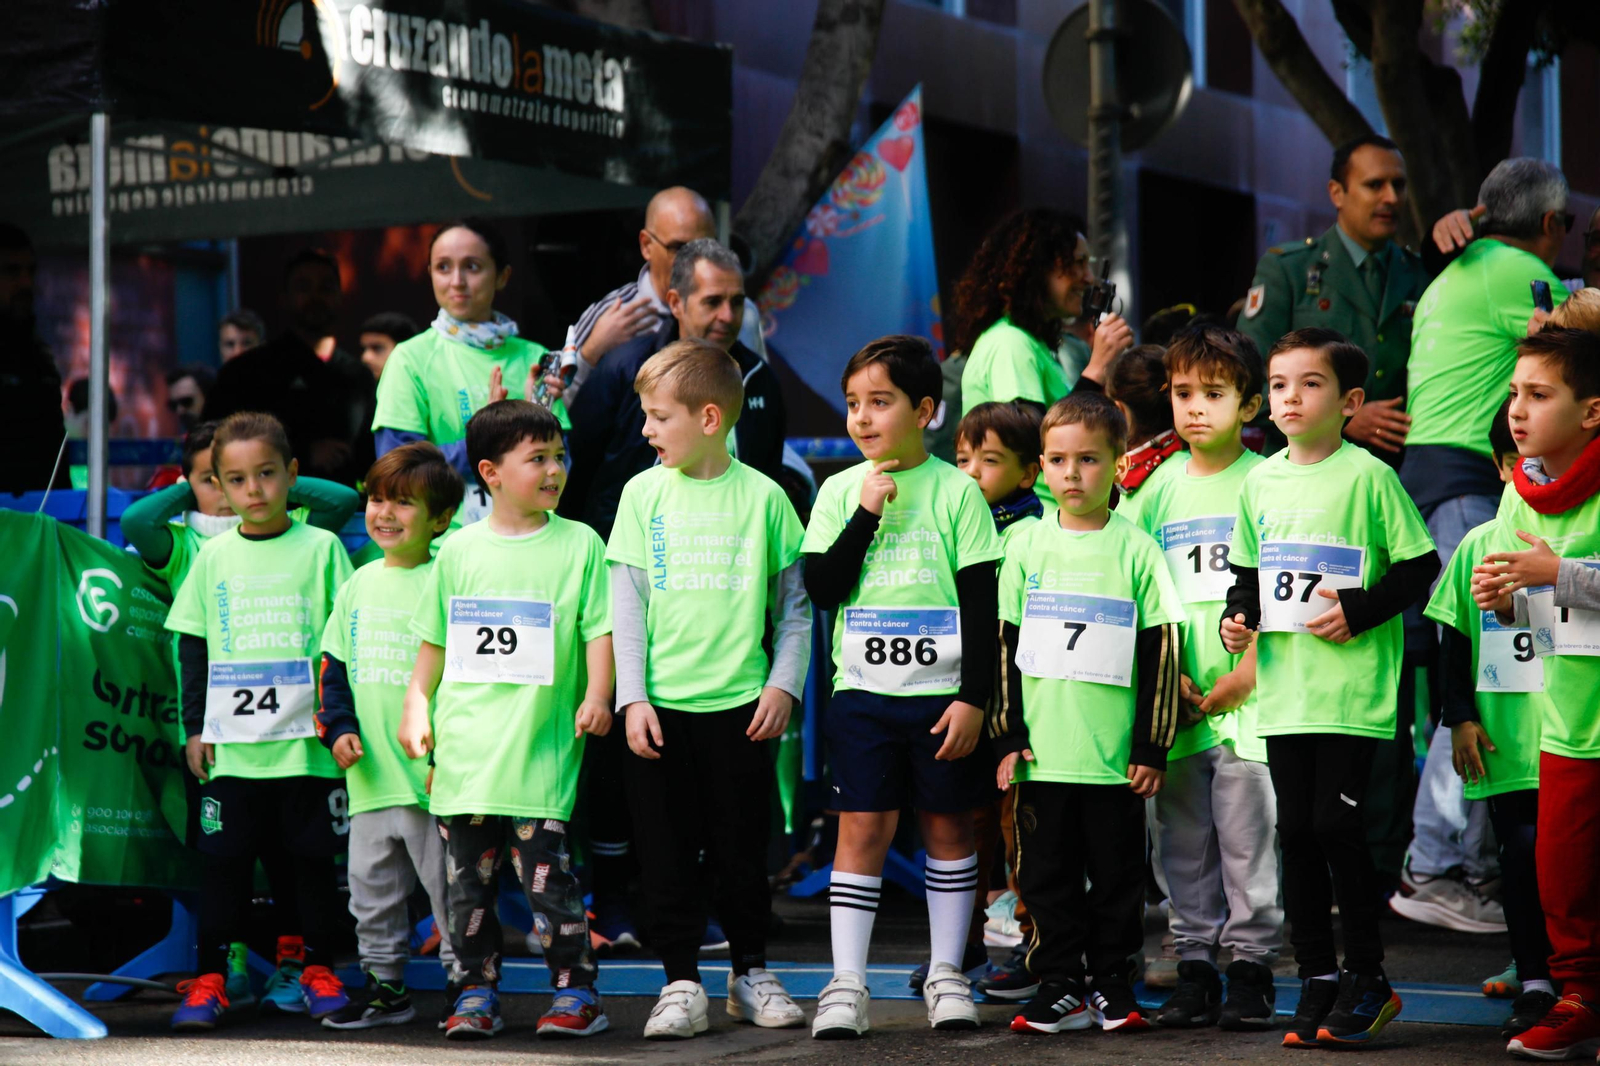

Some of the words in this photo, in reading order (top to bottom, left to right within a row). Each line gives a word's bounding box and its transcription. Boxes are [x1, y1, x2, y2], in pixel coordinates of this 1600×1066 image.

[442, 84, 549, 123] cronometraje
[552, 103, 625, 139] deportivo
[668, 532, 690, 547] En
[694, 532, 754, 548] marcha
[884, 526, 940, 543] marcha
[1166, 533, 1184, 542] contra
[1191, 528, 1216, 537] cáncer
[650, 514, 667, 591] ALMERÍA
[670, 549, 731, 565] contra
[734, 550, 753, 567] el
[864, 545, 919, 565] contra
[923, 544, 938, 561] el
[1187, 543, 1231, 573] 18
[1282, 554, 1308, 563] cáncer
[670, 568, 753, 591] cáncer
[864, 565, 939, 588] cáncer
[1274, 571, 1323, 603] 87
[231, 595, 250, 611] En
[254, 591, 312, 609] marcha
[1029, 595, 1055, 603] Almería
[1059, 605, 1086, 613] cáncer
[214, 581, 231, 653] ALMERÍA
[233, 609, 291, 628] contra
[296, 609, 311, 626] el
[850, 611, 877, 619] Almería
[850, 620, 872, 628] contra
[873, 620, 881, 628] el
[882, 620, 910, 628] cáncer
[235, 627, 311, 651] cáncer
[374, 630, 421, 648] march
[475, 626, 518, 655] 29
[1064, 621, 1087, 651] 7
[1513, 632, 1536, 662] 9
[864, 637, 938, 667] 886
[358, 661, 414, 686] cánce
[232, 686, 280, 716] 24
[327, 788, 351, 836] 9
[532, 863, 550, 893] MARVEL
[466, 908, 485, 937] MARVEL
